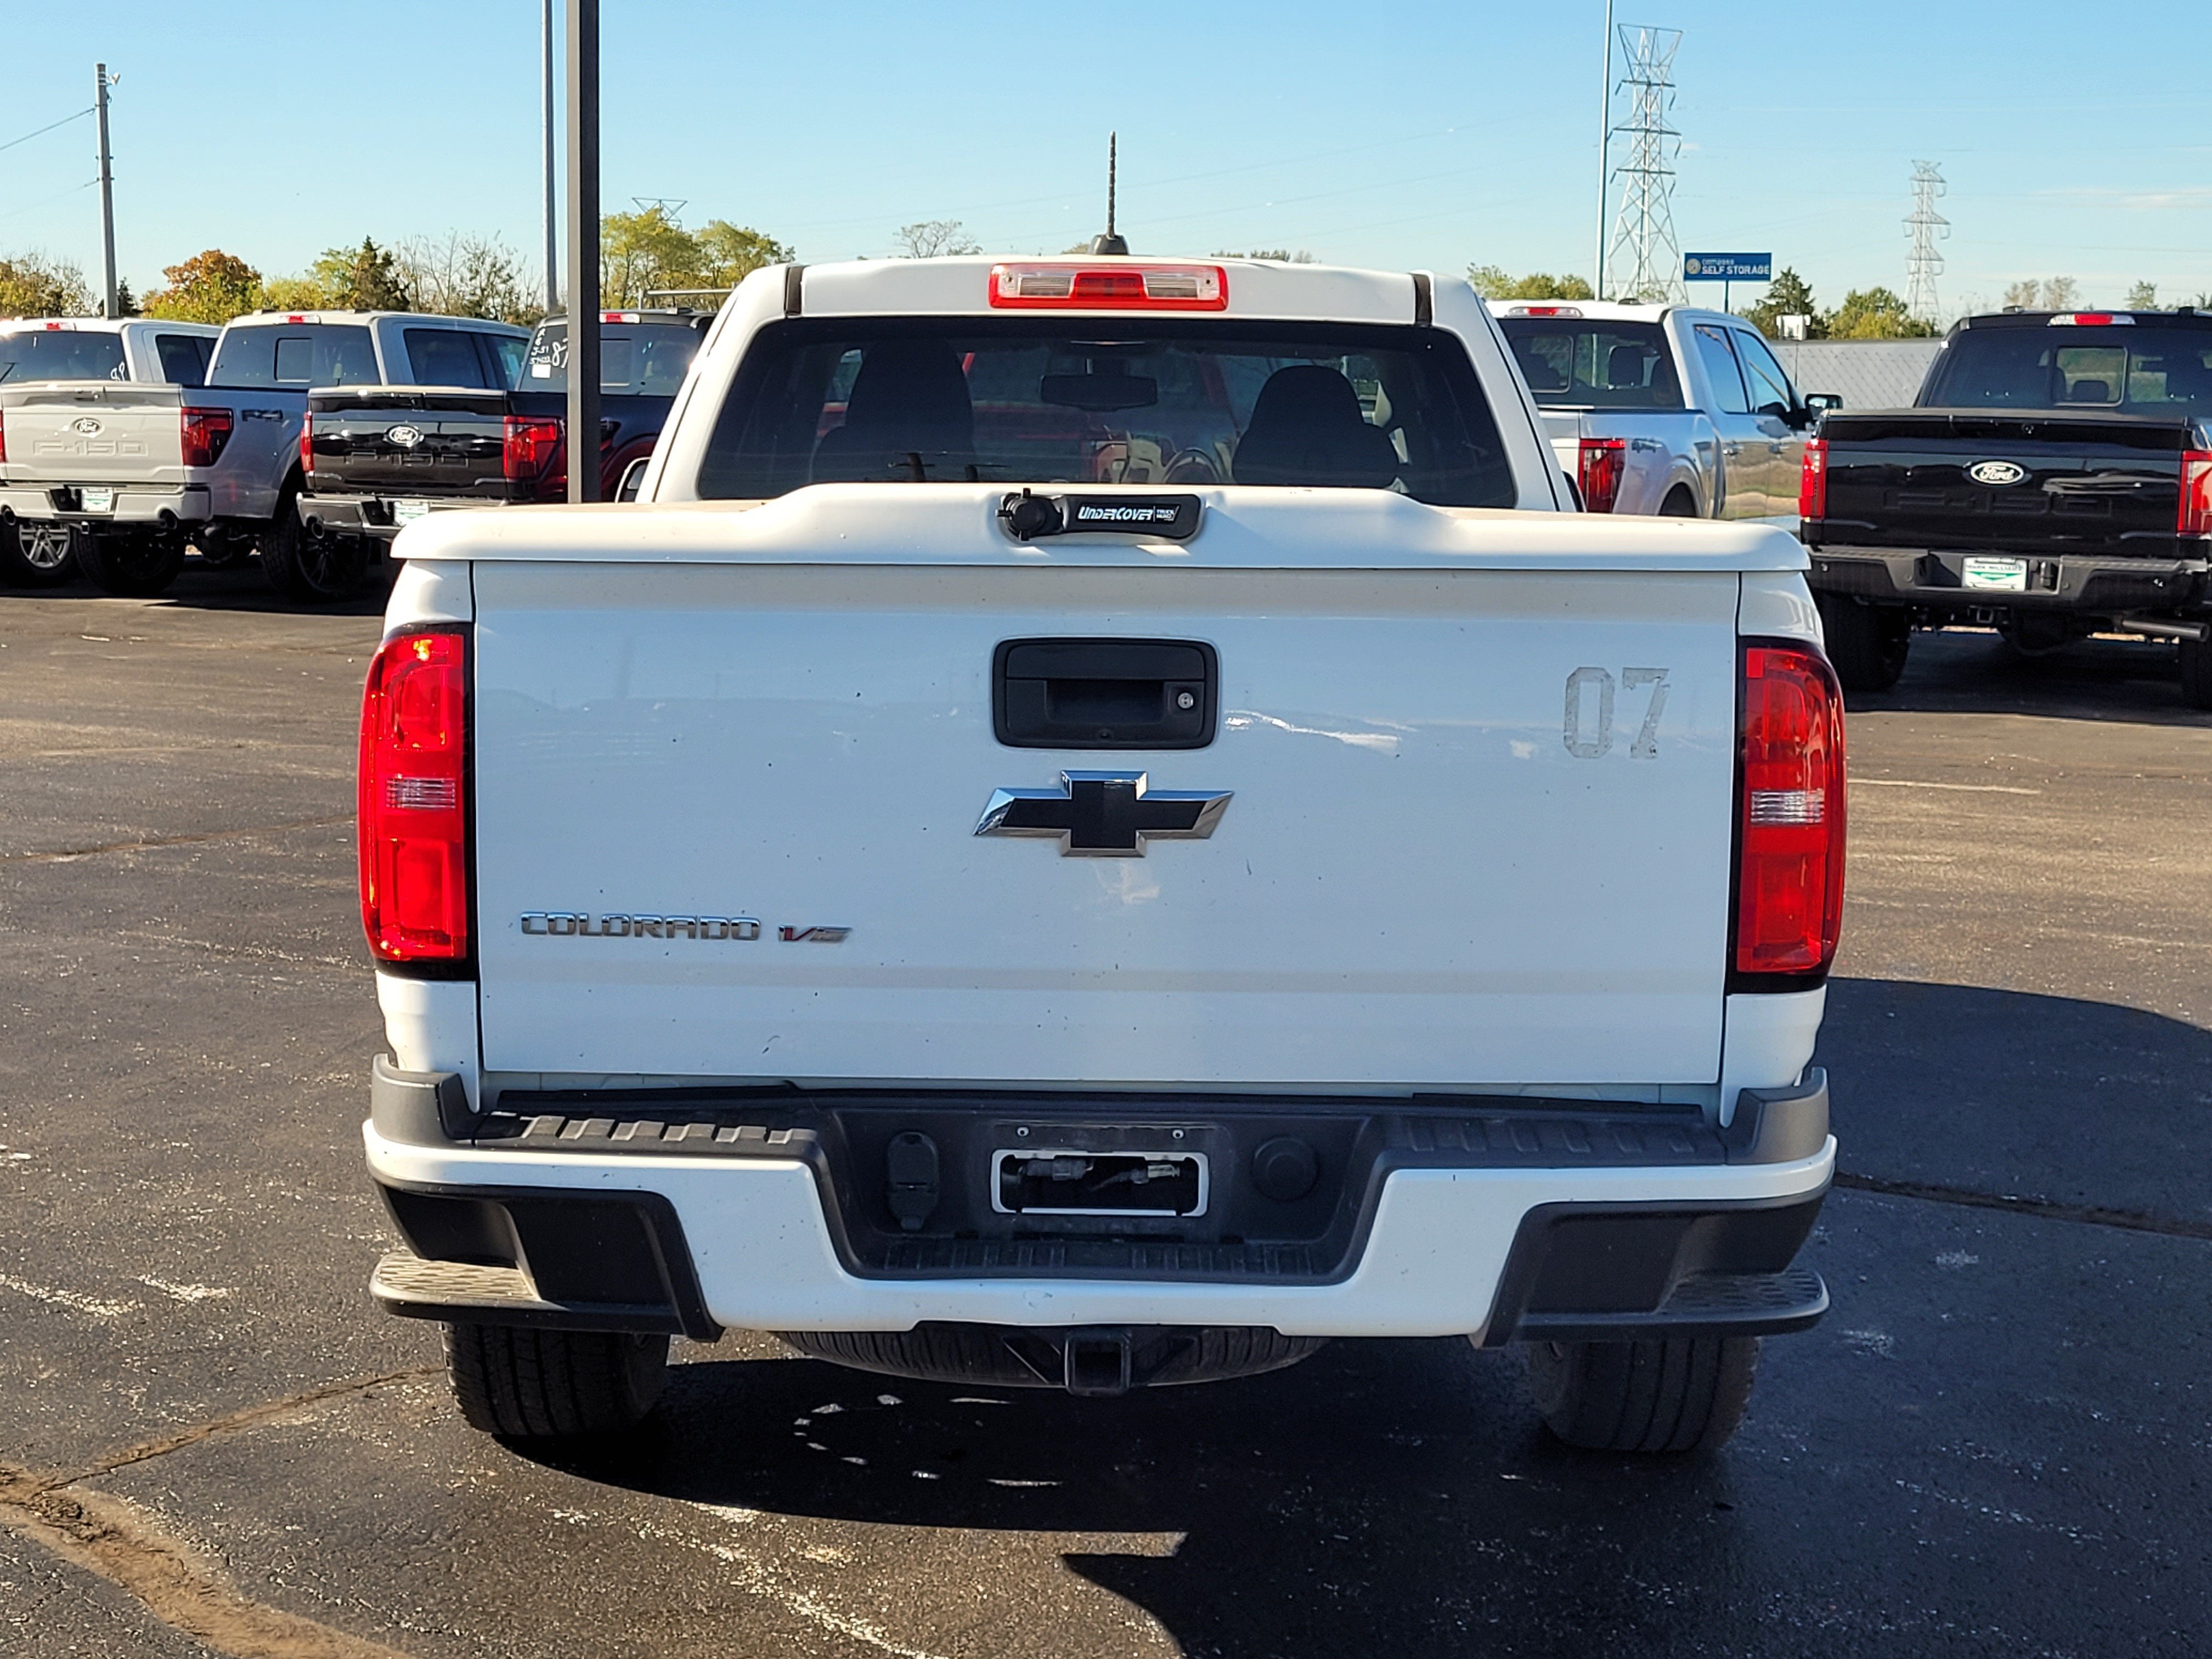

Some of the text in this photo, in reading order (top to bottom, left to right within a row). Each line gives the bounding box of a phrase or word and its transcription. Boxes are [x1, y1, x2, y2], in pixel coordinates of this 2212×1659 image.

[1702, 264, 1769, 275] SELF STORAGE
[33, 441, 148, 456] F-150
[1976, 464, 2019, 481] Ford
[1564, 667, 1670, 759] 07
[521, 911, 760, 941] COLORADO
